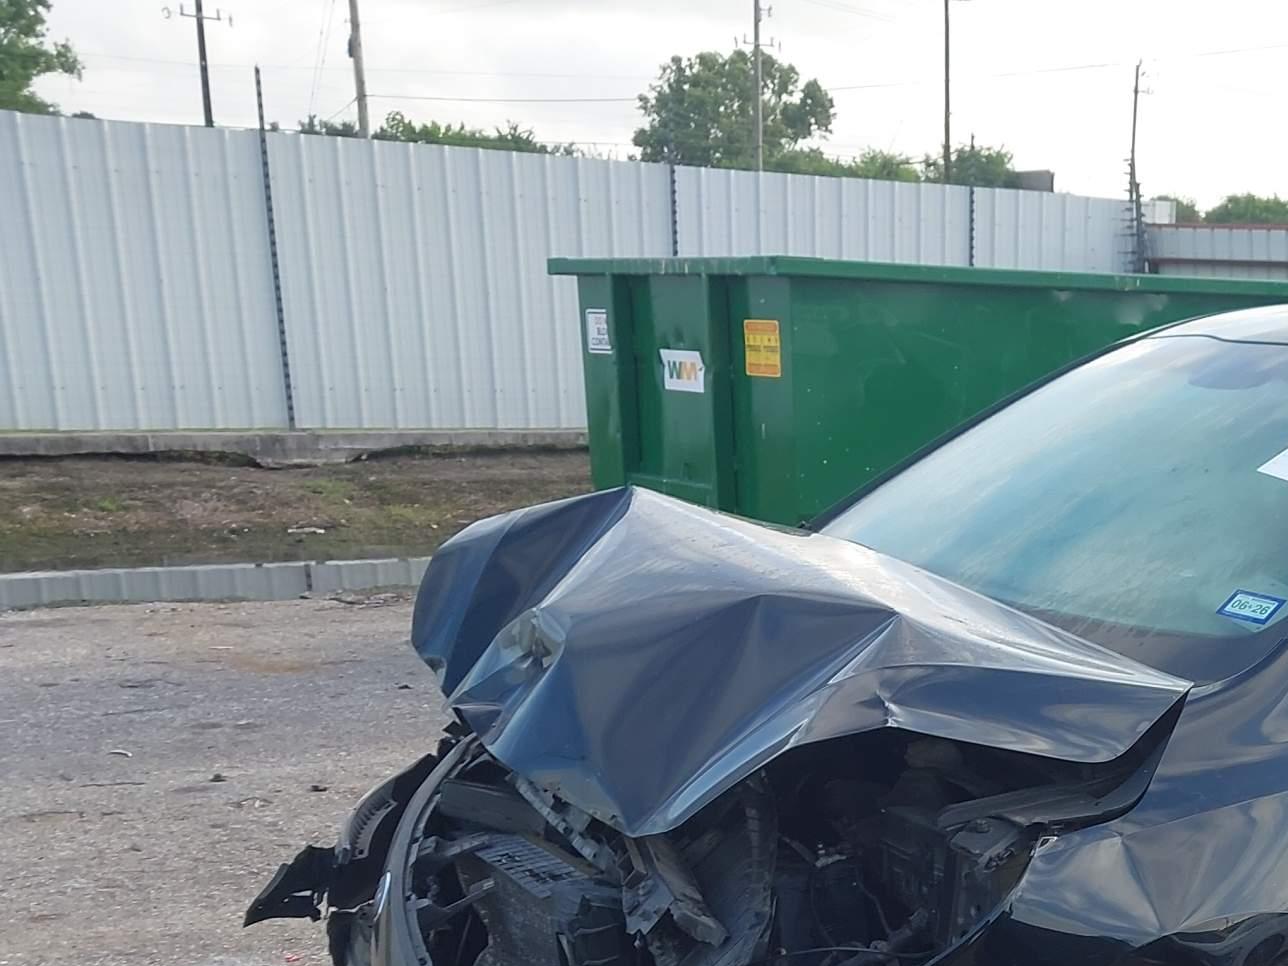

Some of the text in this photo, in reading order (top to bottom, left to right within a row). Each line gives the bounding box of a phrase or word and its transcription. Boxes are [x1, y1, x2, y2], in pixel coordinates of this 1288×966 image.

[667, 359, 698, 380] WM
[1231, 599, 1270, 615] 06 26
